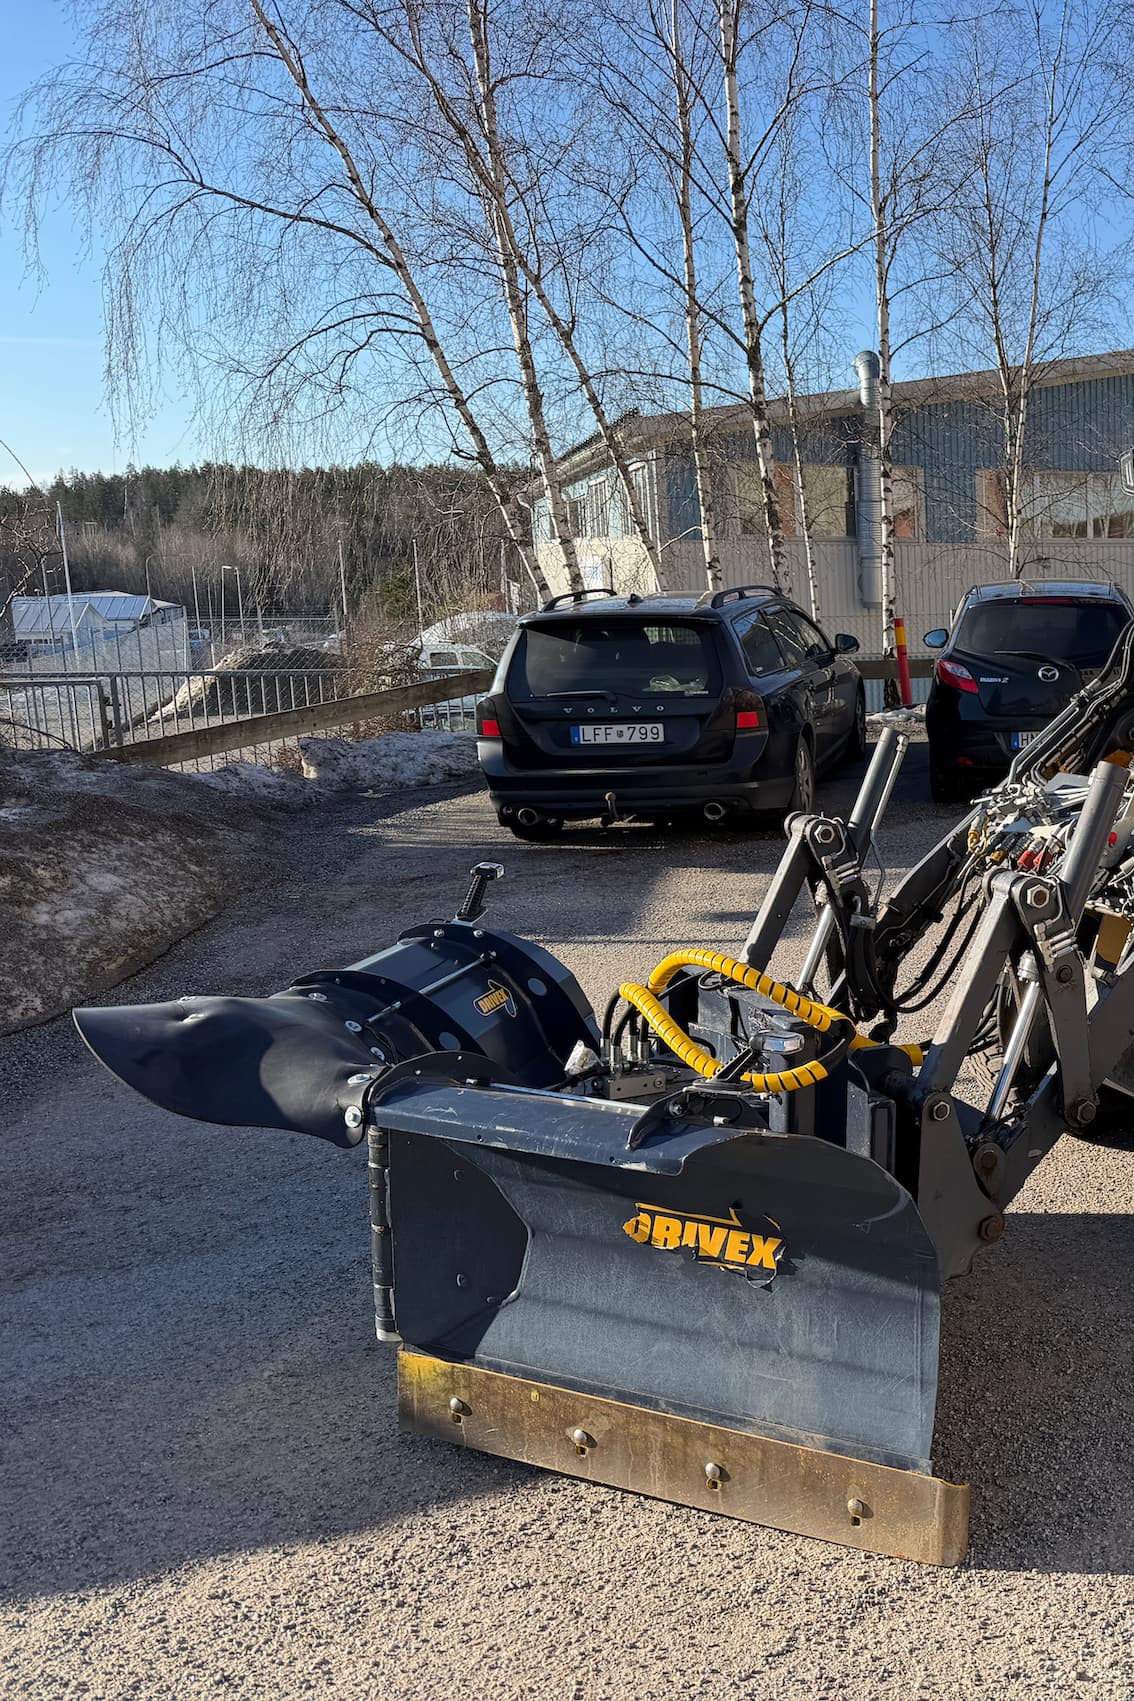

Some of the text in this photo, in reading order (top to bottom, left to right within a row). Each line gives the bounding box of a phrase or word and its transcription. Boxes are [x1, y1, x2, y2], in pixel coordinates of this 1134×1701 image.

[563, 705, 665, 714] VOLVO
[582, 726, 660, 742] LFF 799
